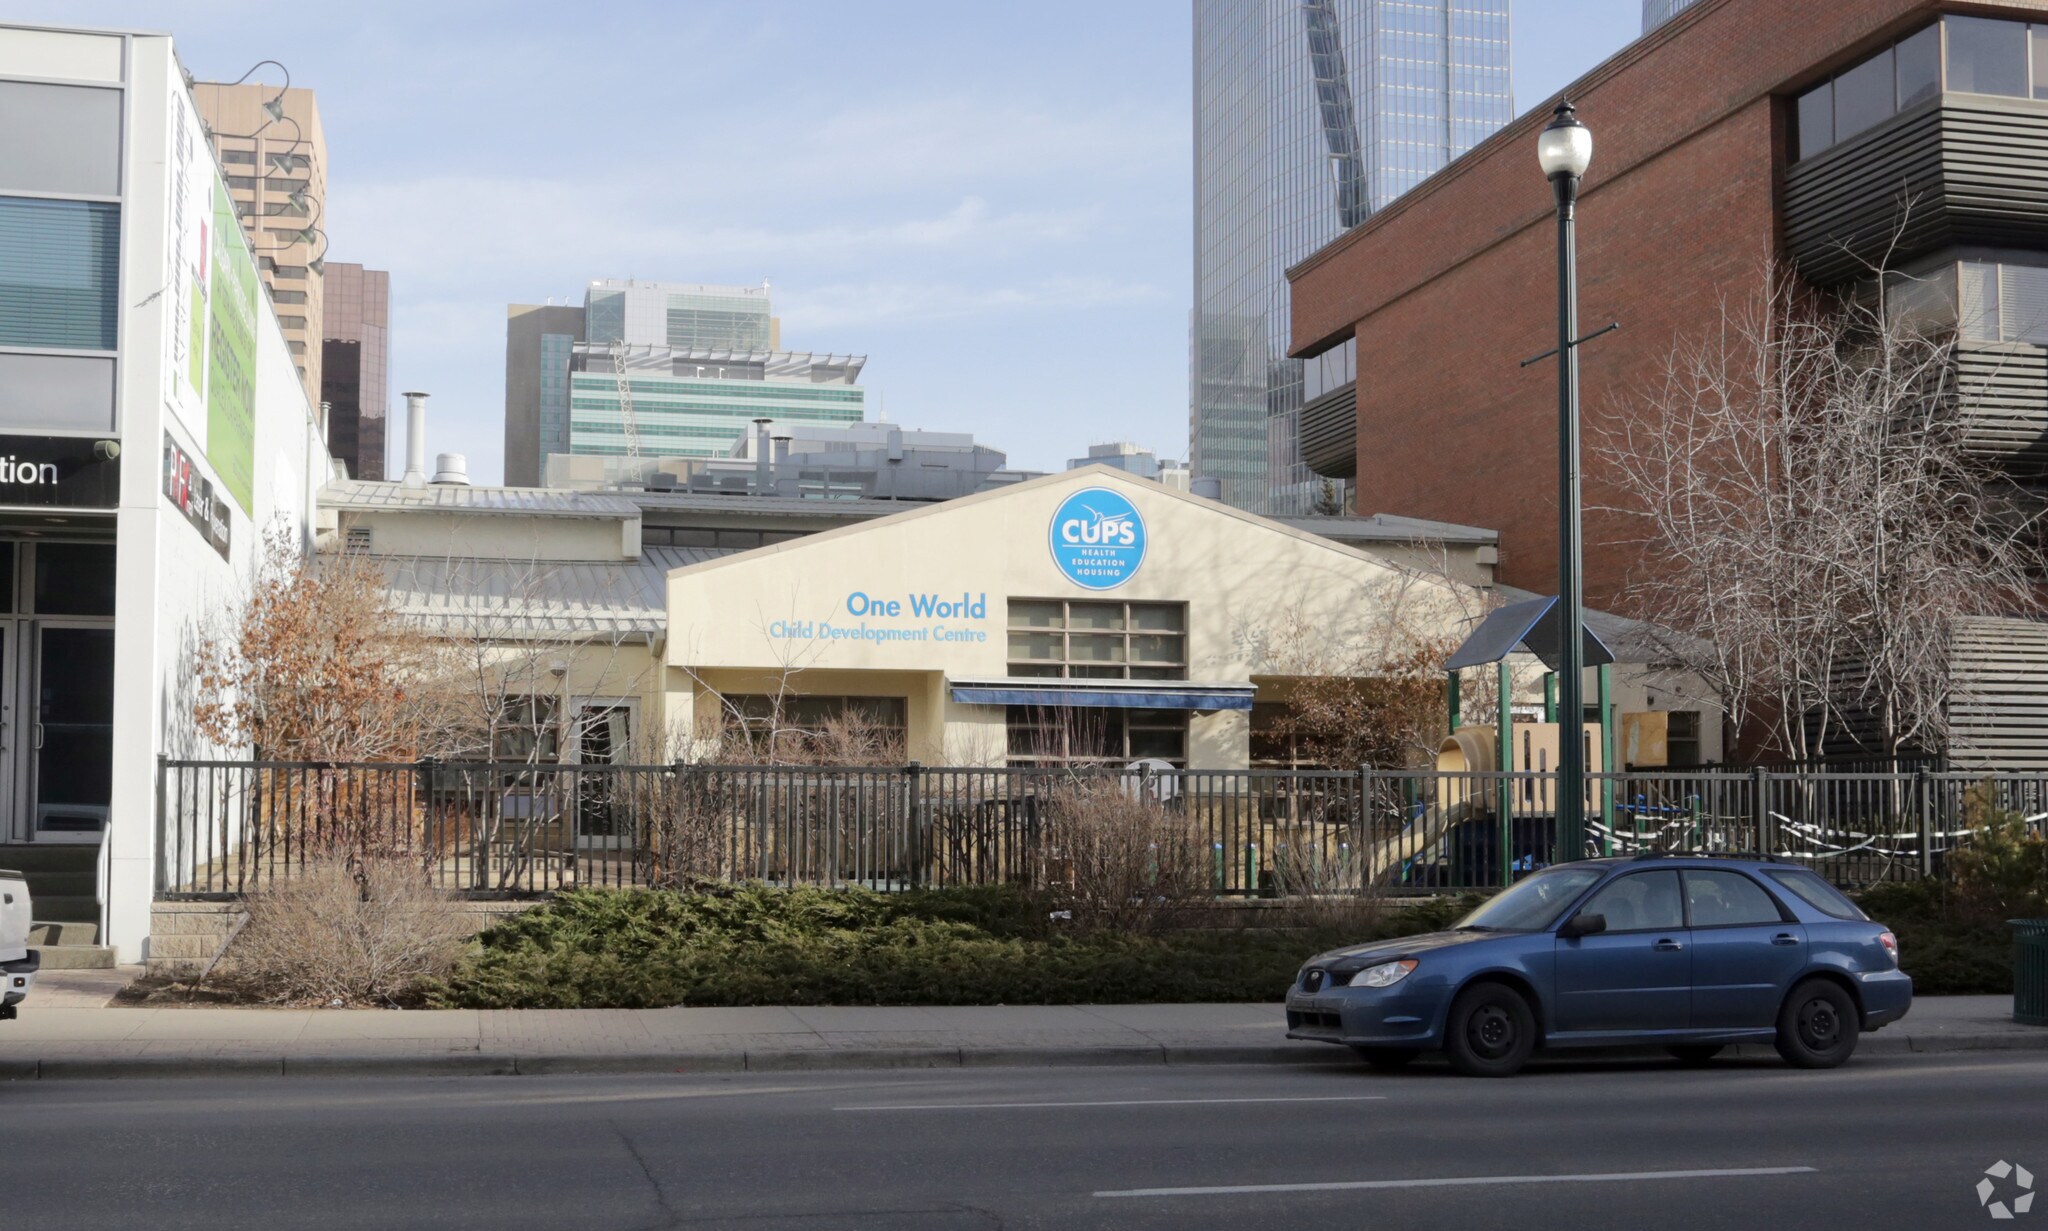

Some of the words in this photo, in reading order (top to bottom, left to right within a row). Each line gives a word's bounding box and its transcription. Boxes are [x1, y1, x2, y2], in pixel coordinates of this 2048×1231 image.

[1062, 519, 1135, 545] CUPS
[1081, 548, 1116, 557] HEALTH
[1071, 558, 1125, 567] EDUCATION
[1077, 568, 1120, 577] HOUSING
[846, 591, 901, 617] One
[909, 592, 986, 619] World
[769, 620, 813, 639] Child
[819, 622, 928, 645] Development
[933, 625, 987, 642] Centre
